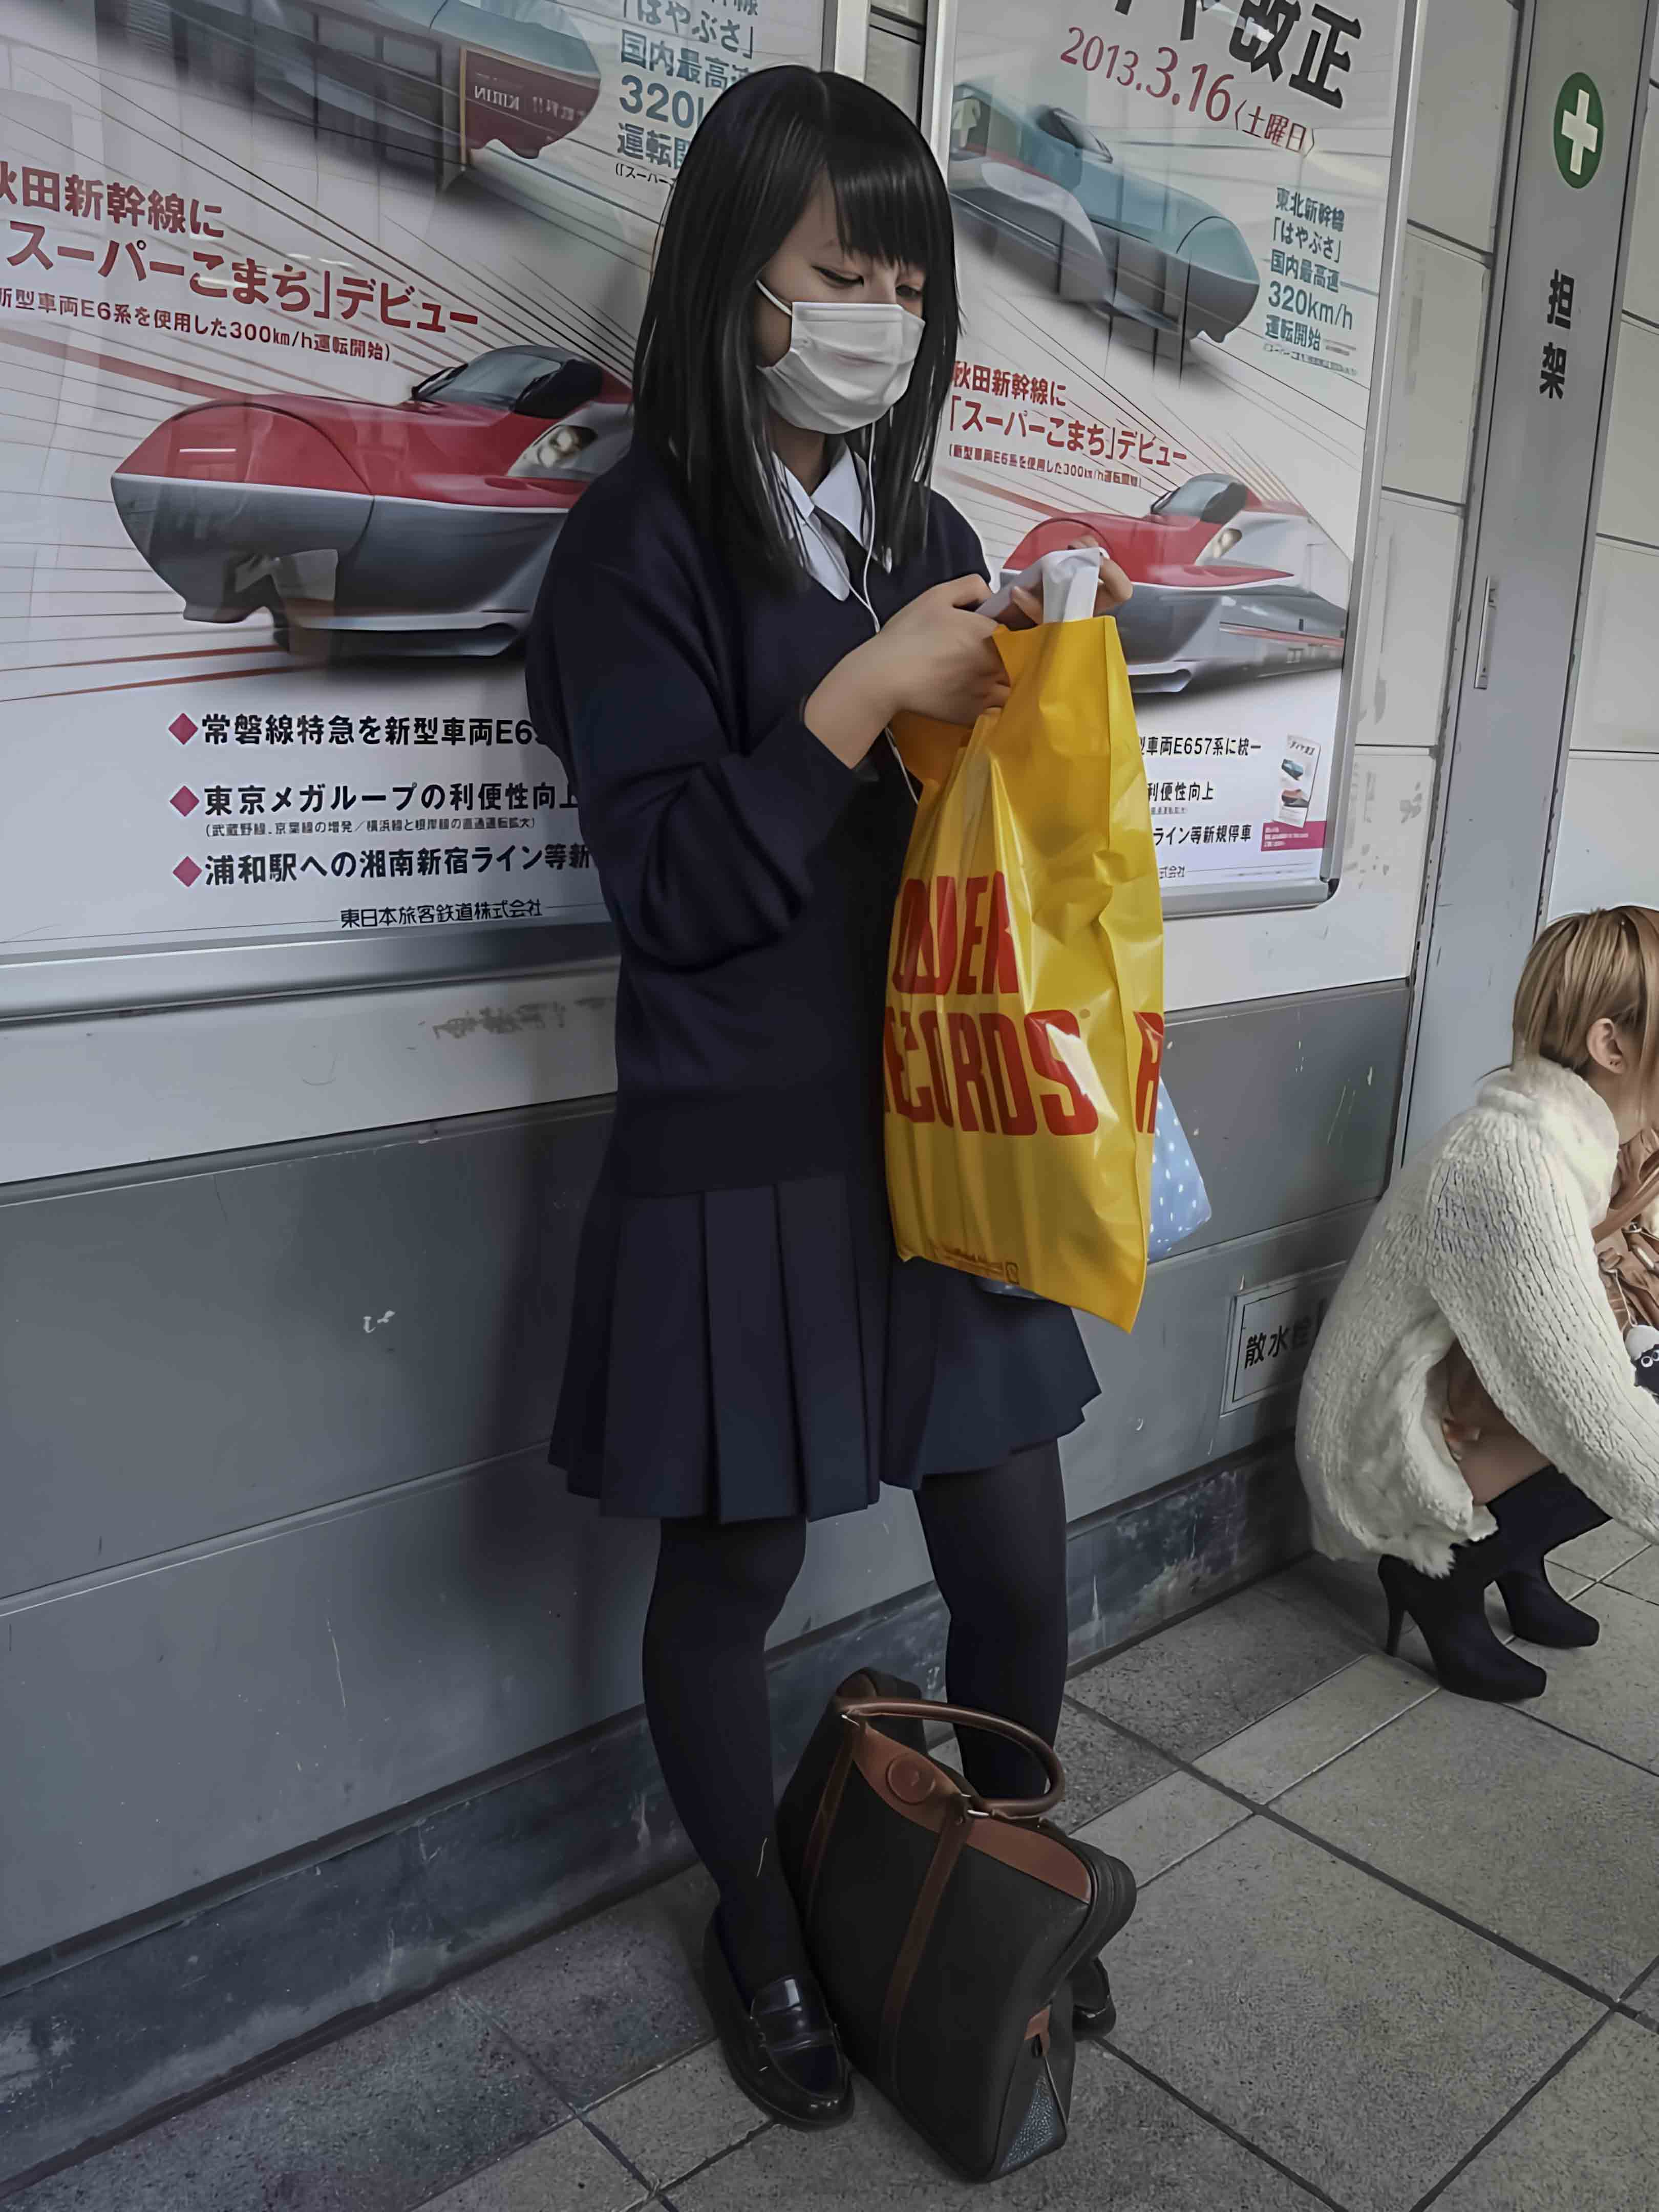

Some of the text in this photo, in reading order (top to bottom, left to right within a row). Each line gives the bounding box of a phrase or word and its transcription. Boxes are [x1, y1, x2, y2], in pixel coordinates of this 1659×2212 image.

[1276, 187, 1345, 232] 東北新幹線
[1273, 217, 1342, 263] 「はやぶさ」
[1270, 249, 1340, 293] 国内最高速
[1268, 281, 1353, 330] 320km/h
[1265, 314, 1322, 351] 運転開始
[1539, 268, 1575, 399] 担架
[953, 360, 1066, 406] 秋田新幹線に
[950, 395, 1187, 466] 「スーパーこまち」デビュー
[1153, 824, 1252, 845] ライン等新規停車
[1244, 1315, 1309, 1369] 散水
